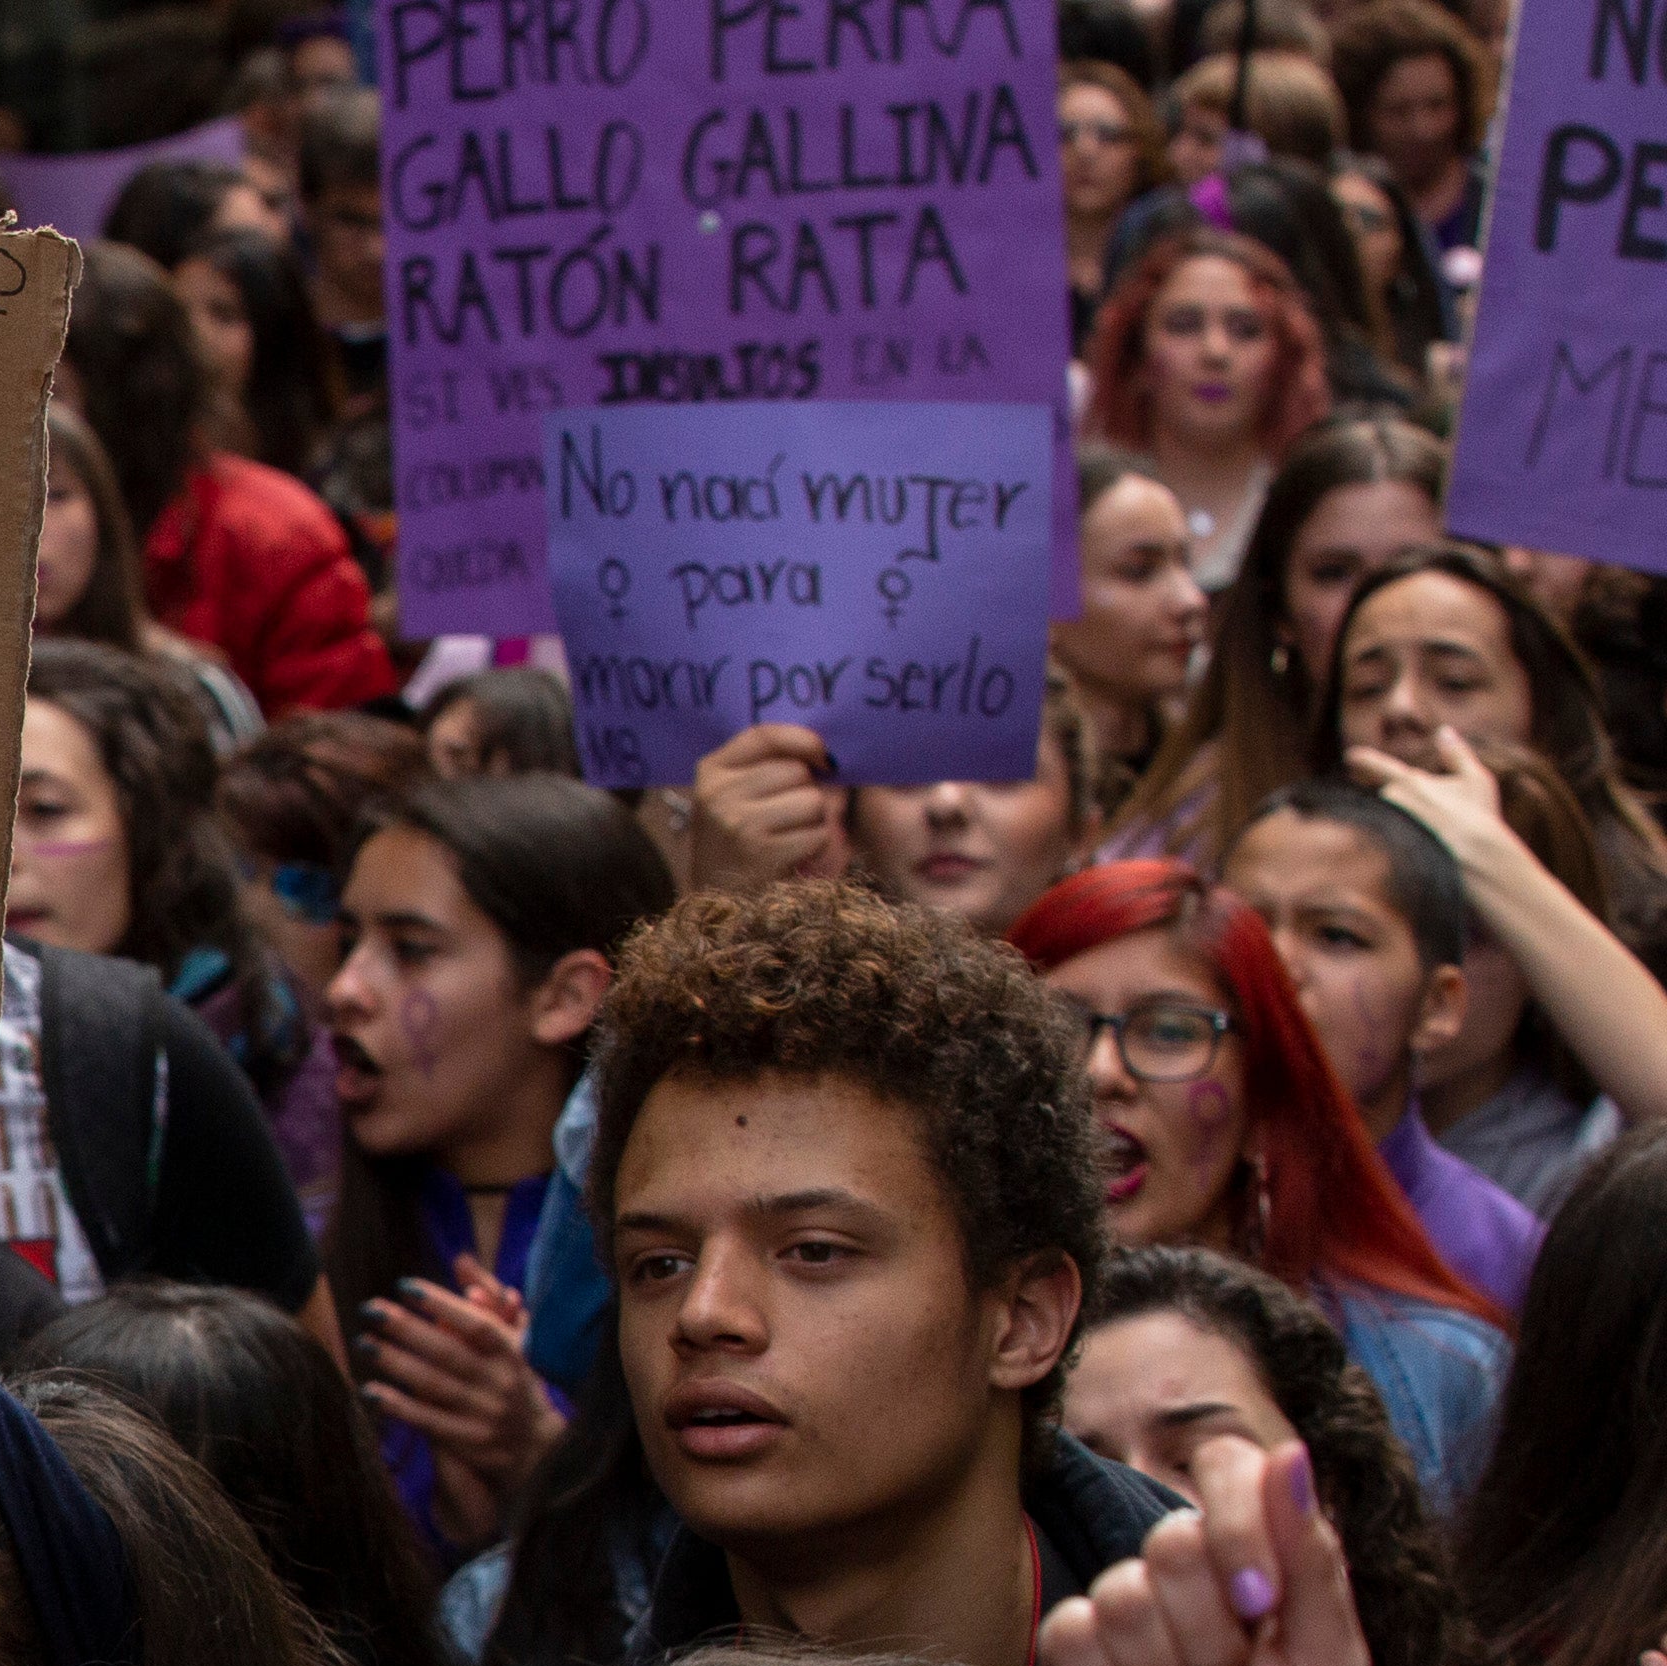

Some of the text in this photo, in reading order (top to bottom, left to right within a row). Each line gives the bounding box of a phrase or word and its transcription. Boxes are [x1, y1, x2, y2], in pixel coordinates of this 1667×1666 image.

[387, 0, 651, 109] PERRO
[389, 84, 1042, 234] GALLO GALLINA
[398, 205, 970, 348] RATÓN RATA
[598, 340, 820, 405] INSULTOS
[558, 424, 636, 520] No
[671, 559, 822, 629] para
[751, 656, 852, 722] por
[865, 636, 1014, 718] serlo
